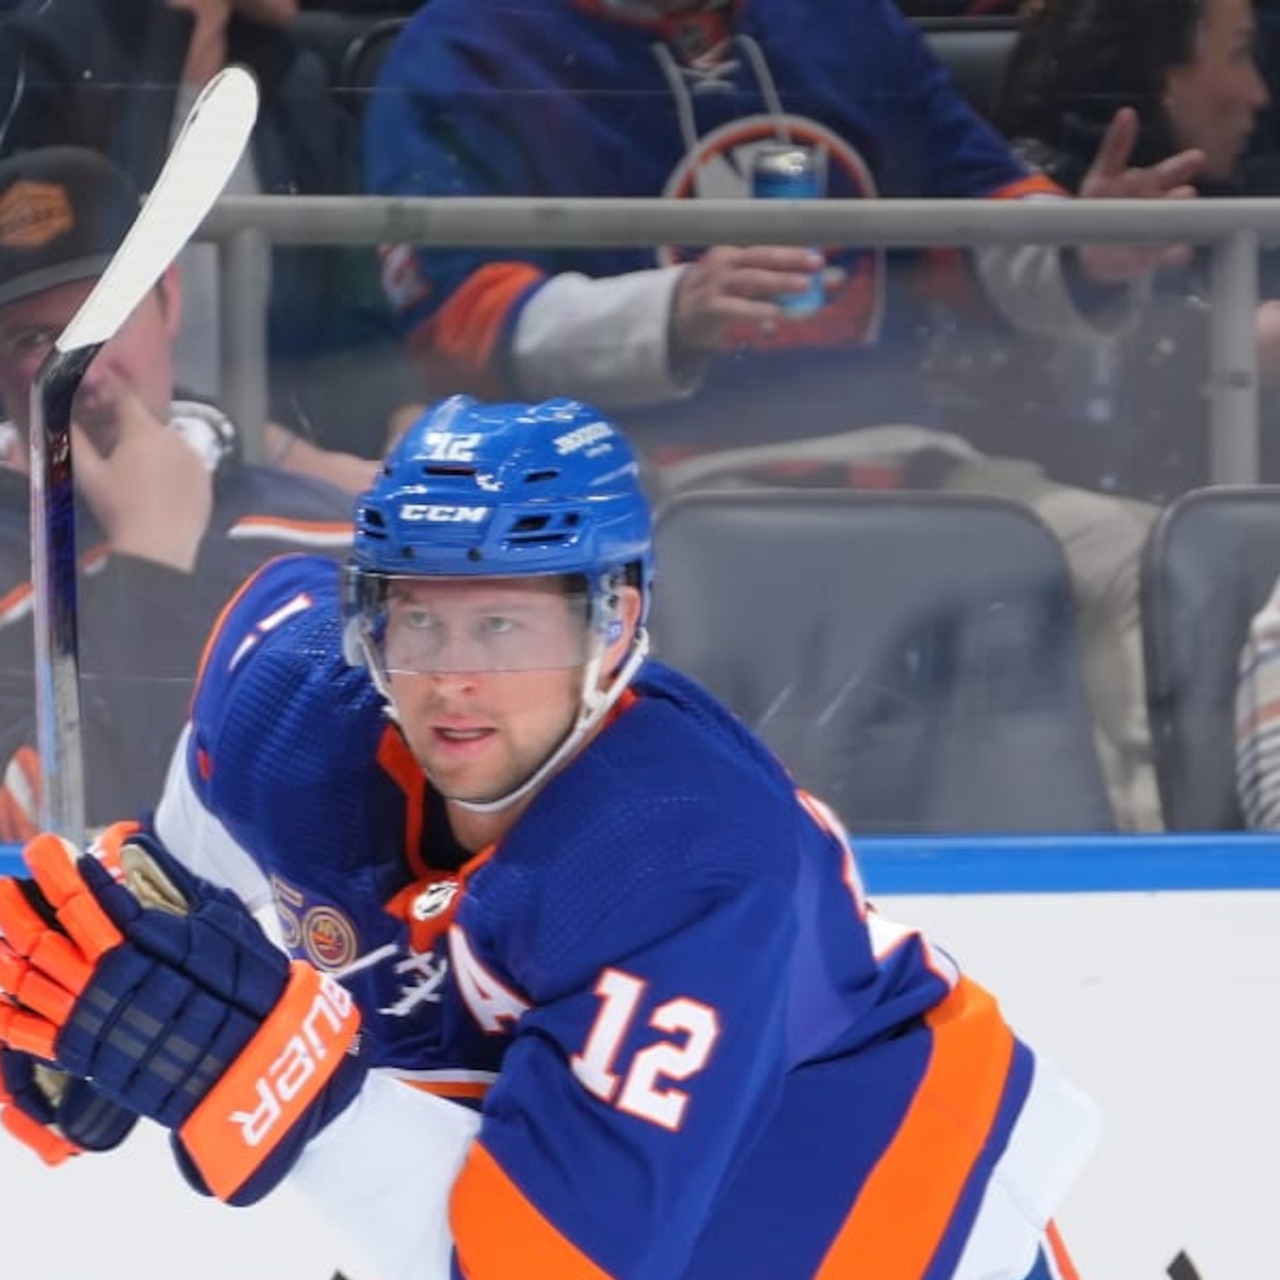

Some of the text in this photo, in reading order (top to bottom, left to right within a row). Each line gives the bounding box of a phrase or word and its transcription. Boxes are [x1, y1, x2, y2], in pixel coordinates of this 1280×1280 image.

[400, 504, 489, 522] CCM
[448, 924, 531, 1034] A
[229, 972, 352, 1147] AUER
[570, 967, 720, 1132] 12
